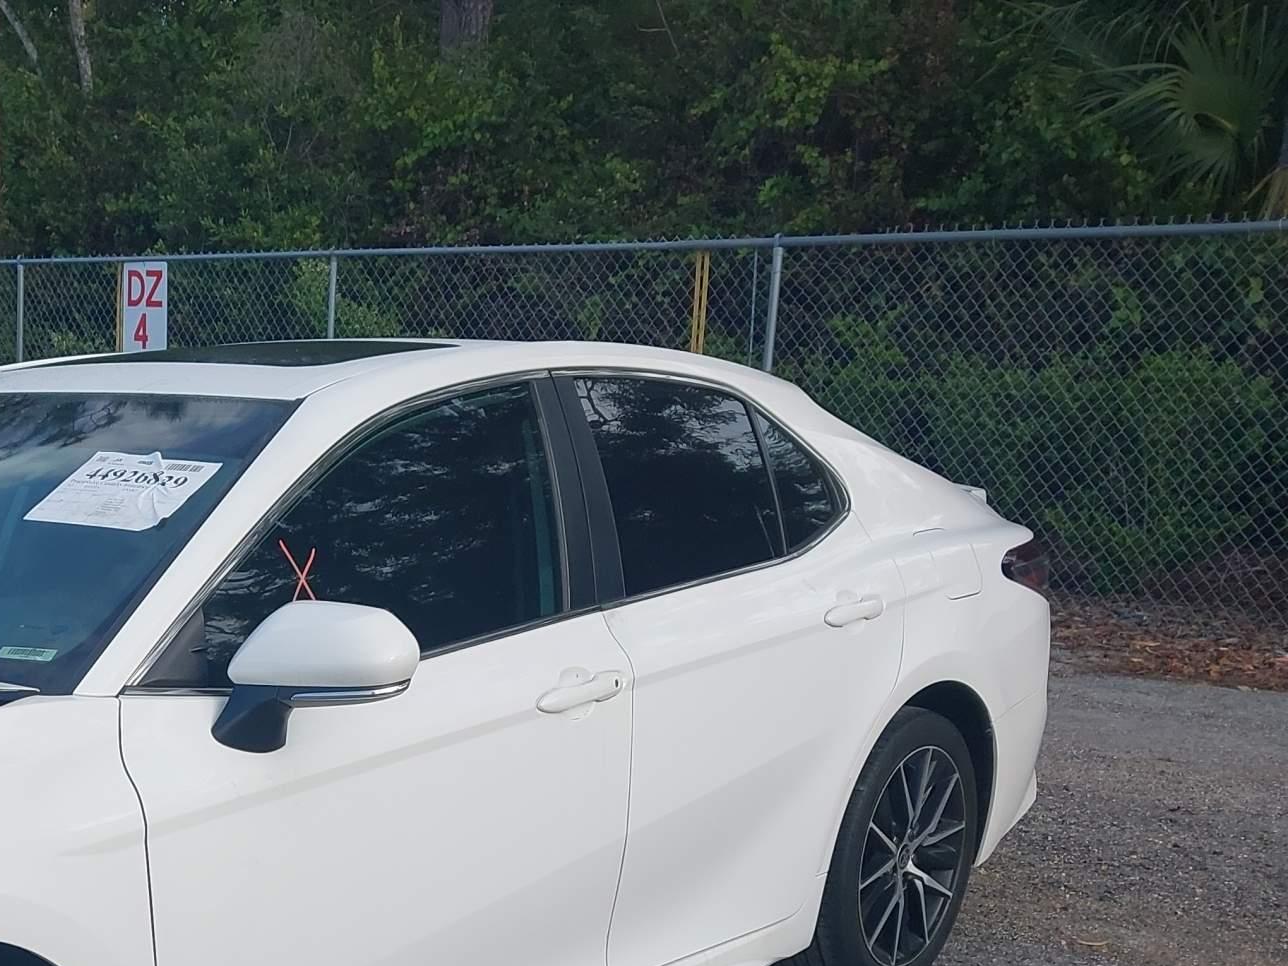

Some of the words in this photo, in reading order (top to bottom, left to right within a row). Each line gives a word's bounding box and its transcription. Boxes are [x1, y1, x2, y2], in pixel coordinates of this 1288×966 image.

[128, 270, 163, 307] DZ
[134, 313, 148, 349] 4
[85, 467, 189, 489] 44926829
